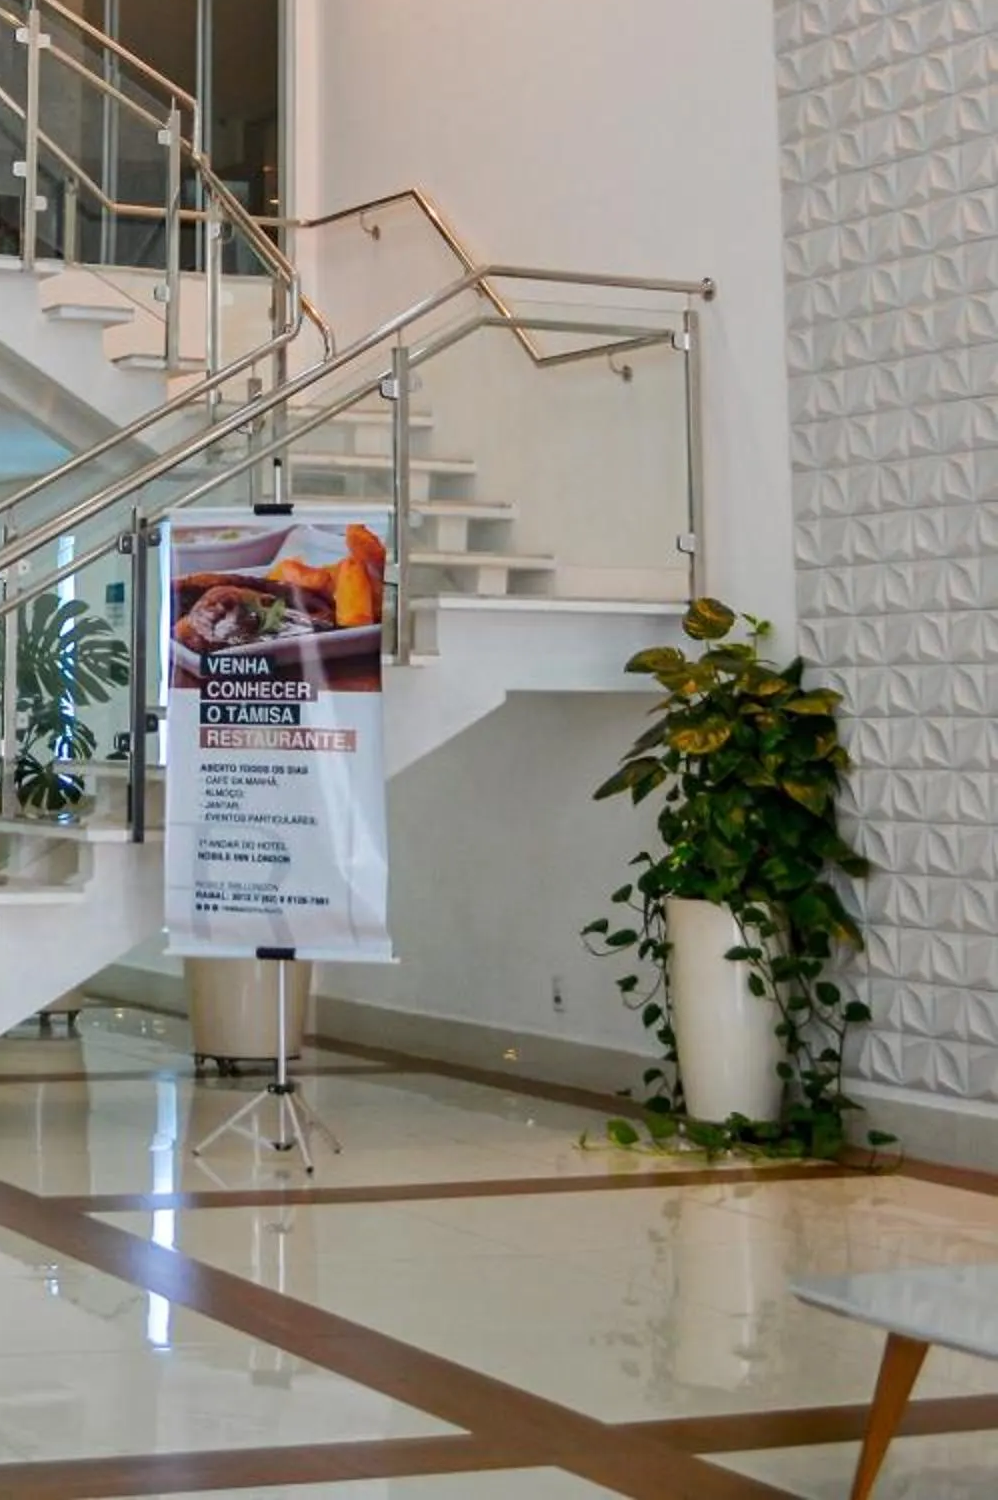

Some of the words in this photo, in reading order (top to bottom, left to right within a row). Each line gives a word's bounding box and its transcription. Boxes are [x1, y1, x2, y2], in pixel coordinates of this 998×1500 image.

[207, 657, 269, 675] VENHA
[207, 681, 311, 698] CONHECER
[207, 706, 221, 723] O
[207, 729, 352, 749] RESTAURANTE.
